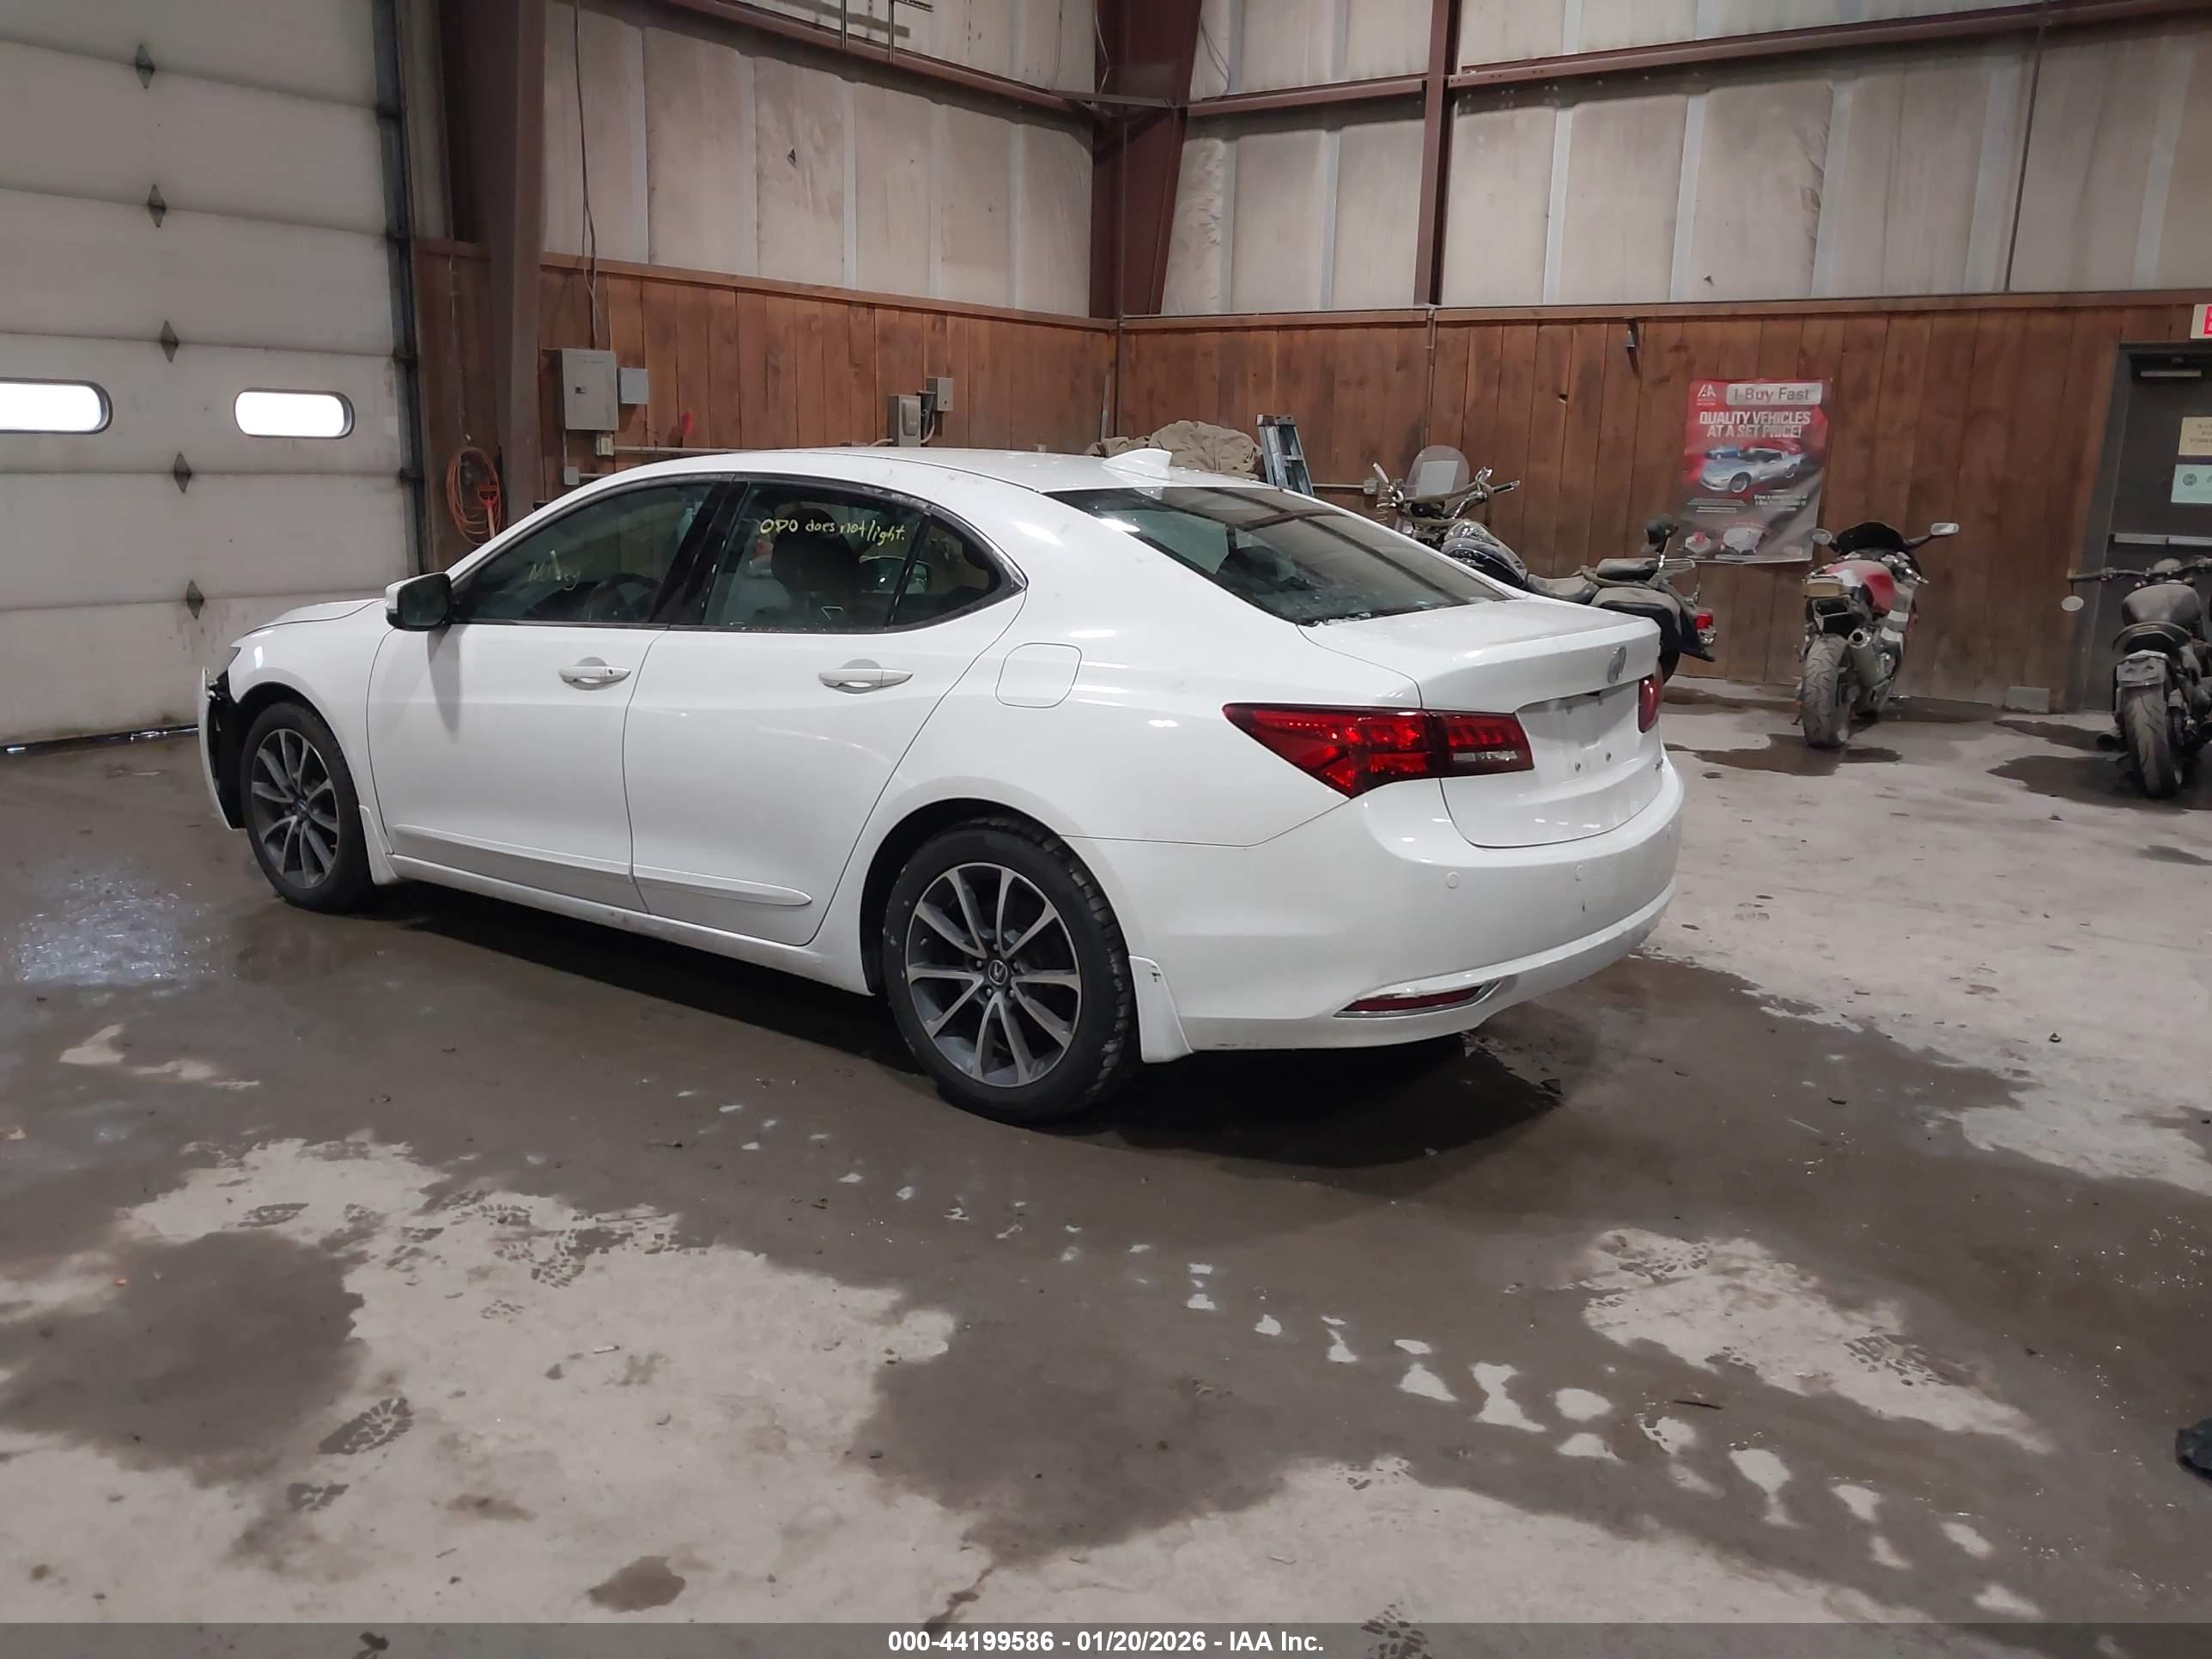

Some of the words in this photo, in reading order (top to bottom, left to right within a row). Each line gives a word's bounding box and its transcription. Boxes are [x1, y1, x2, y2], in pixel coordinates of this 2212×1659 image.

[1734, 387, 1774, 404] I-Buy
[1778, 386, 1809, 400] Fast
[1699, 411, 1751, 425] QUALITY
[1753, 411, 1811, 425] VEHICLES
[1707, 424, 1723, 438] AT
[1725, 424, 1735, 438] A
[1737, 424, 1760, 438] SET
[1762, 424, 1802, 439] PRICE!
[805, 520, 836, 533] does
